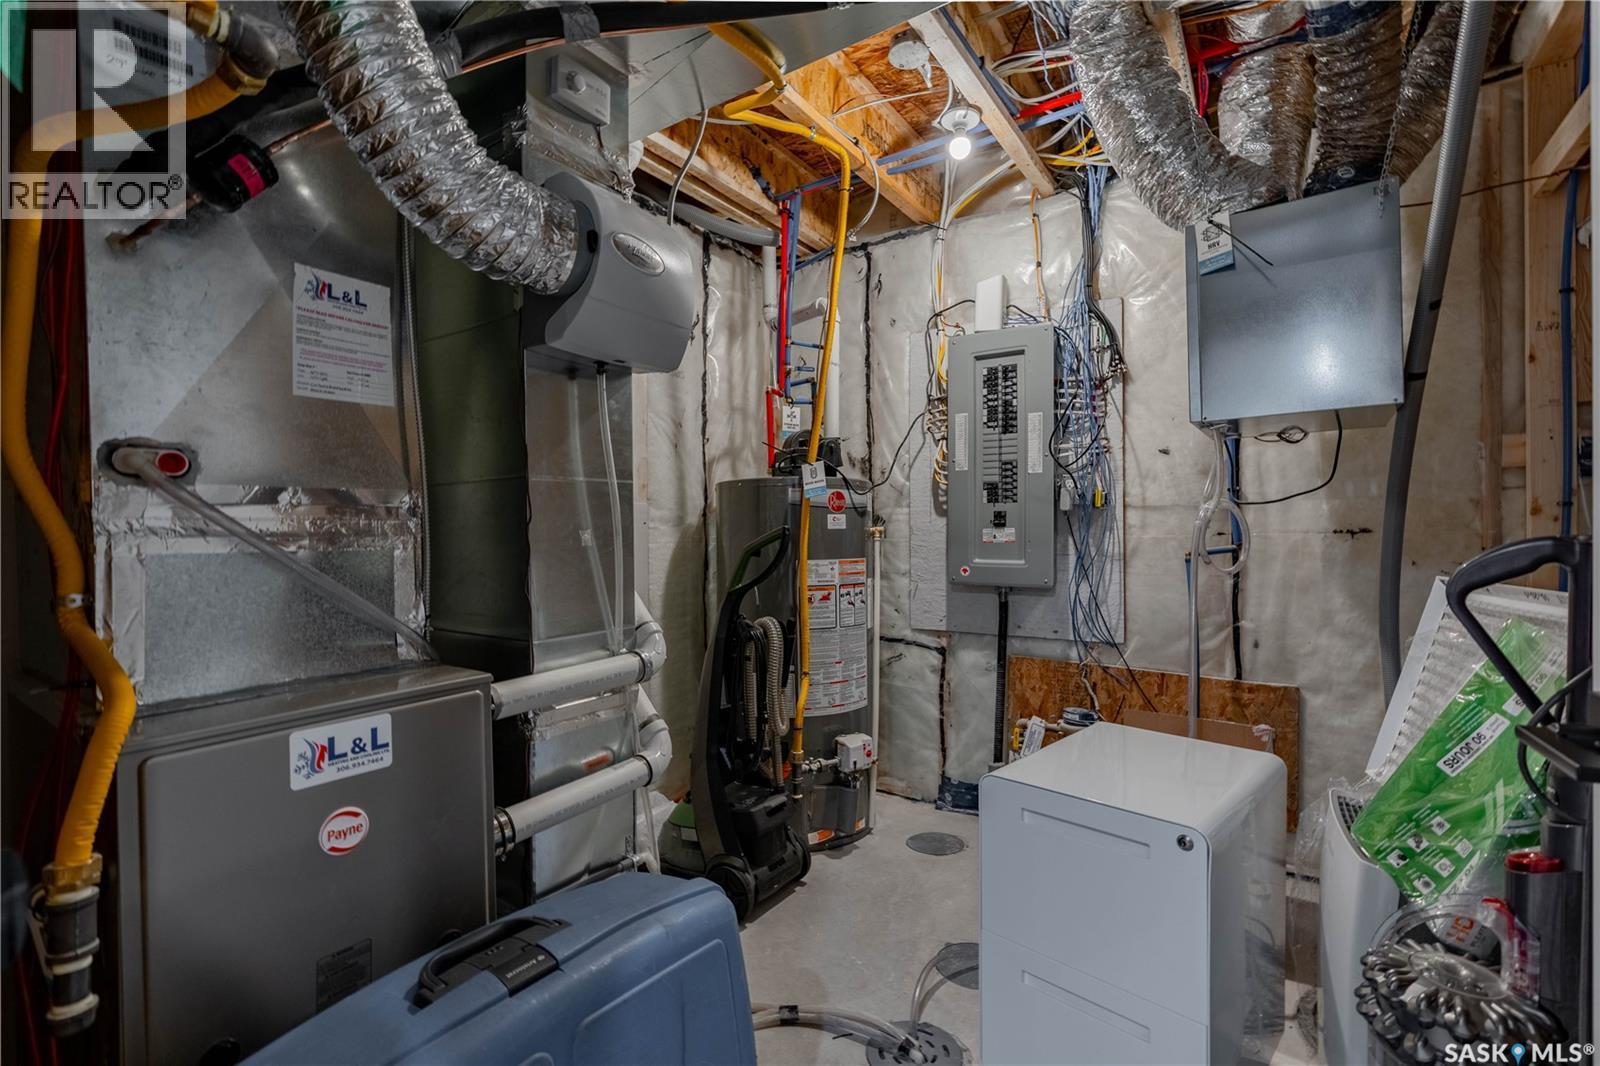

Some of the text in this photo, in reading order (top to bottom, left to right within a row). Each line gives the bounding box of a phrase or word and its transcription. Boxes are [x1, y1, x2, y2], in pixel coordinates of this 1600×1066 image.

[327, 283, 367, 308] L & L
[328, 727, 389, 761] L & L
[1443, 731, 1486, 769] 90 JOURS
[336, 756, 384, 773] 306.934.7464
[327, 823, 364, 843] Payne
